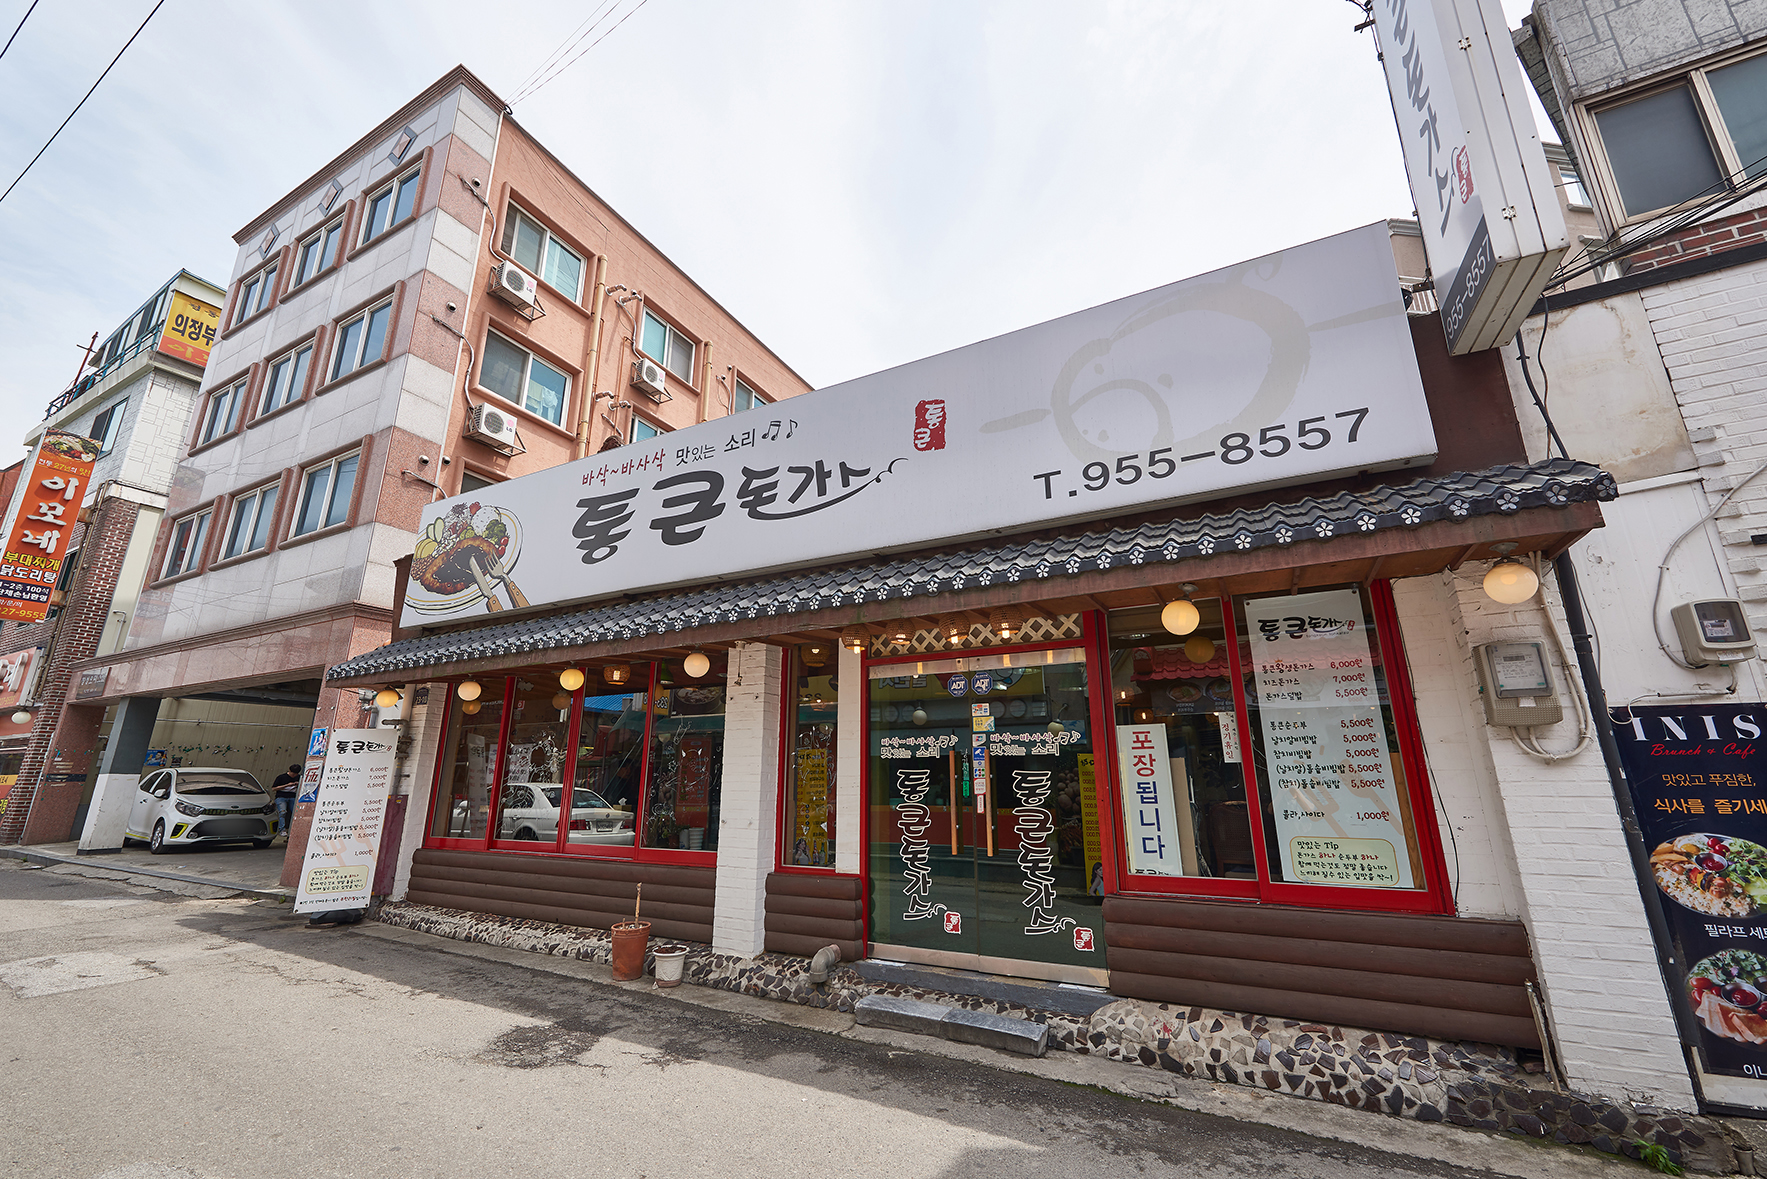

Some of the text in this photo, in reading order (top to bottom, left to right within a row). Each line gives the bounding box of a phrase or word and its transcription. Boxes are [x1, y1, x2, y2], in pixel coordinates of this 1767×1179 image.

[1447, 234, 1491, 339] 955-8557
[171, 313, 217, 346] 의정부
[581, 428, 756, 487] 바삭~바사삭 맛있는 소리
[1033, 407, 1369, 499] T.955-8557
[21, 476, 79, 554] 이모네
[3, 551, 61, 571] 부대찌개
[0, 564, 57, 583] 닭도리탕
[0, 607, 45, 619] 27-9555
[1330, 658, 1363, 670] 6,000원
[951, 680, 965, 690] ADT
[975, 679, 990, 691] ADT
[1333, 673, 1366, 684] 7,000원
[1335, 687, 1368, 698] 5,500원
[1341, 718, 1374, 729] 5,500원
[1631, 714, 1761, 741] INIS
[1222, 723, 1234, 759] 정기휴일
[1343, 733, 1376, 744] 5,000원
[1031, 742, 1059, 755] 소리
[1346, 747, 1379, 758] 5,000원
[1650, 743, 1702, 756] Brunch
[1722, 742, 1756, 759] Cafe
[1348, 763, 1382, 774] 5,500원
[1351, 778, 1385, 789] 5,500원
[1662, 773, 1756, 787] 맛있고 푸짐한,
[1131, 731, 1165, 859] 포장됩니다
[1654, 798, 1705, 814] 식사를
[1357, 811, 1390, 821] 1,000원
[1297, 841, 1339, 850] 맛있는 Tip
[1704, 923, 1748, 938] 필라프
